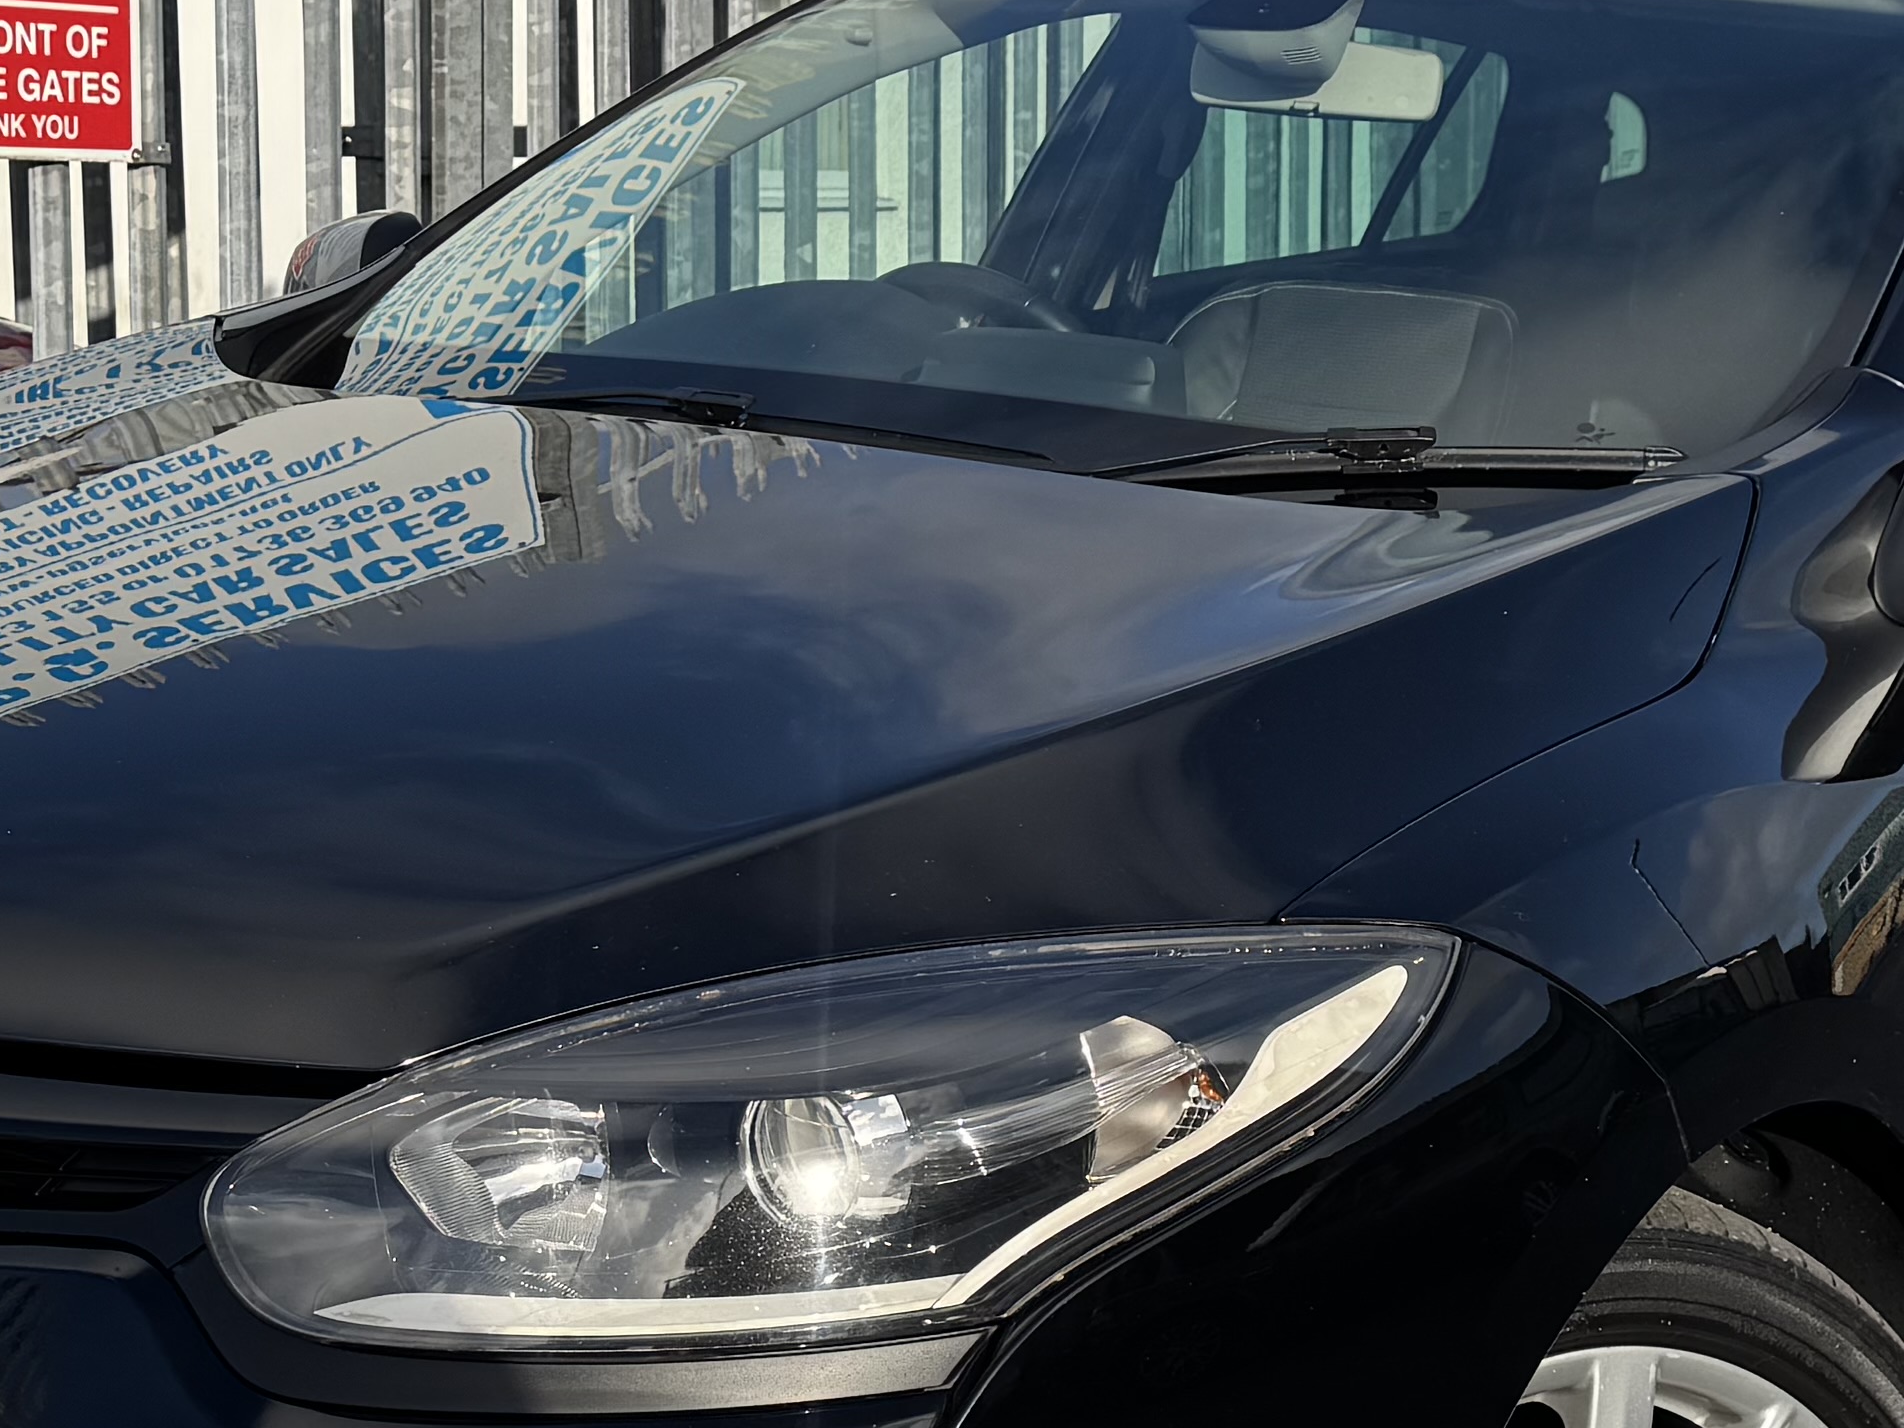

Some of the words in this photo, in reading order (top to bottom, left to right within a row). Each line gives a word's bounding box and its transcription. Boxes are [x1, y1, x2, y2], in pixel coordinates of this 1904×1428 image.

[65, 24, 109, 59] OF
[17, 67, 121, 106] GATES
[31, 114, 79, 140] YOU
